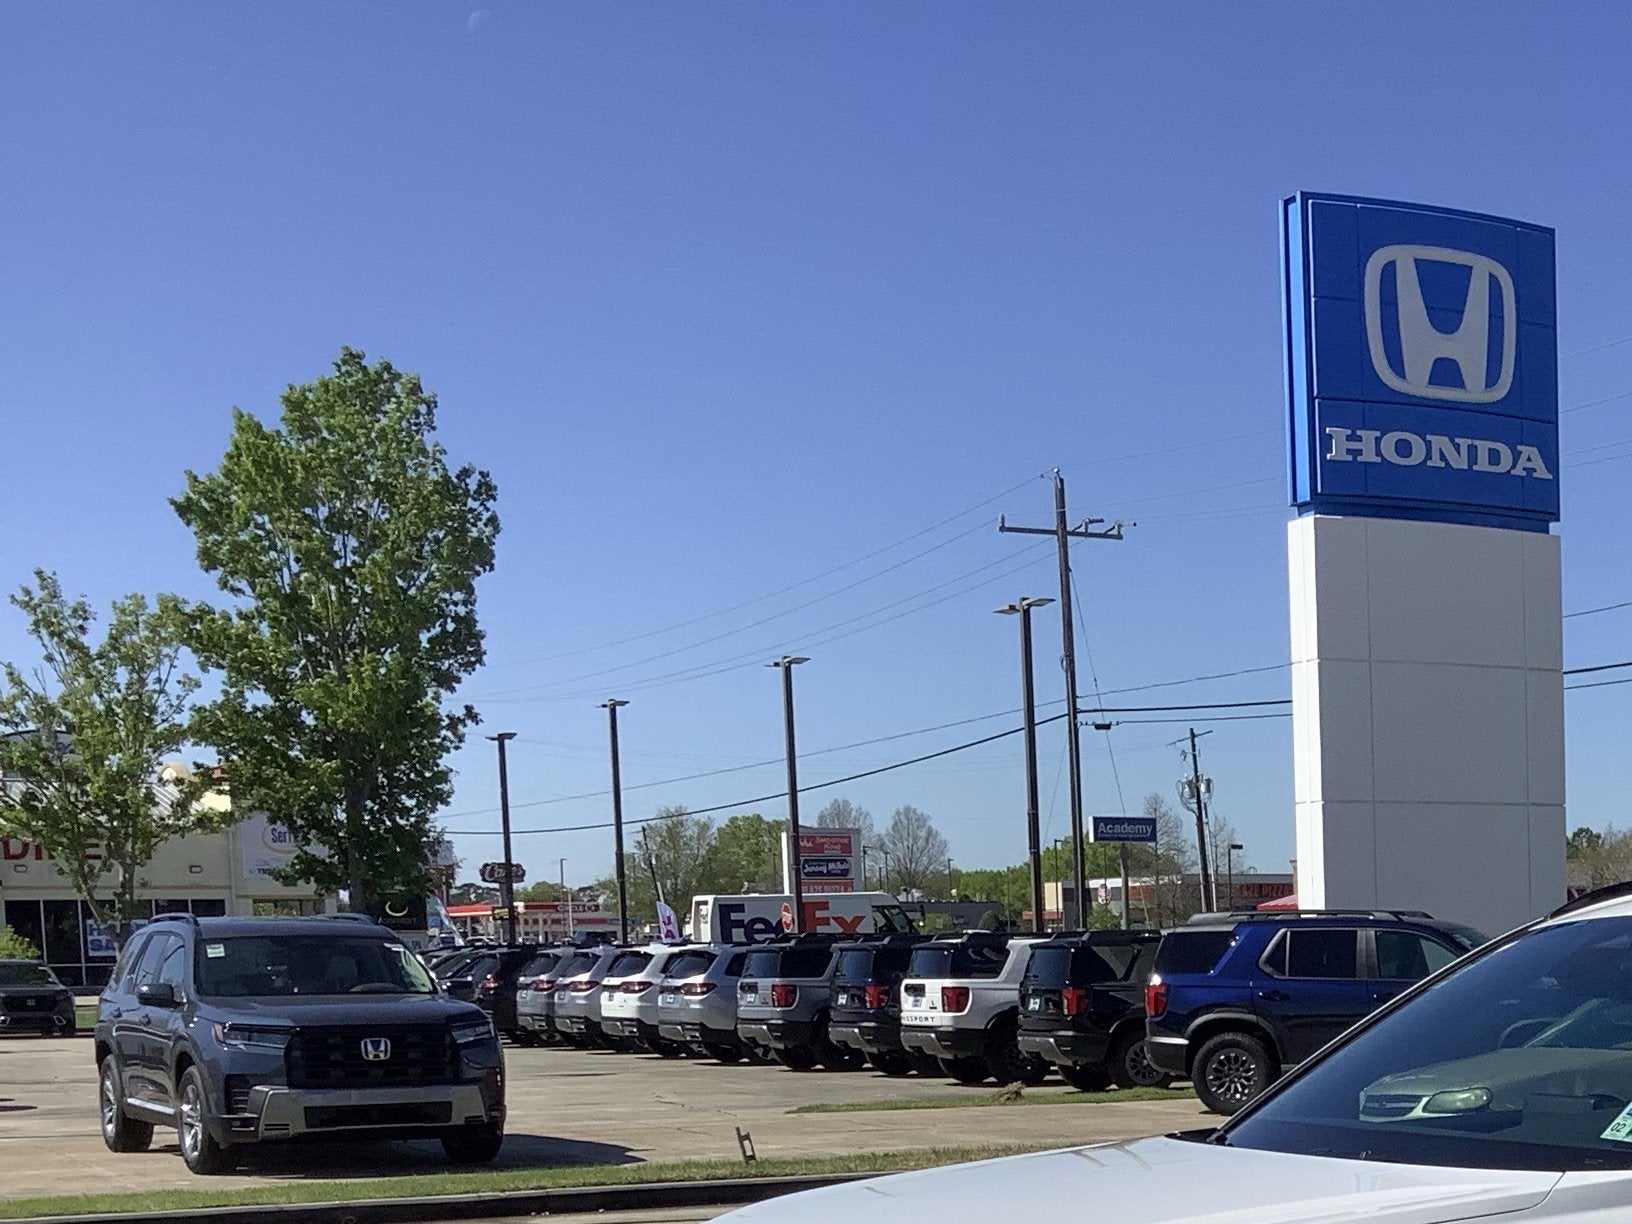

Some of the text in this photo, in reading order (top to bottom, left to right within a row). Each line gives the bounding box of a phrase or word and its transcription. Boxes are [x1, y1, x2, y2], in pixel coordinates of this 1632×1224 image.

[1325, 427, 1553, 480] HONDA
[1098, 822, 1153, 837] Academy
[1610, 1122, 1627, 1133] 02
